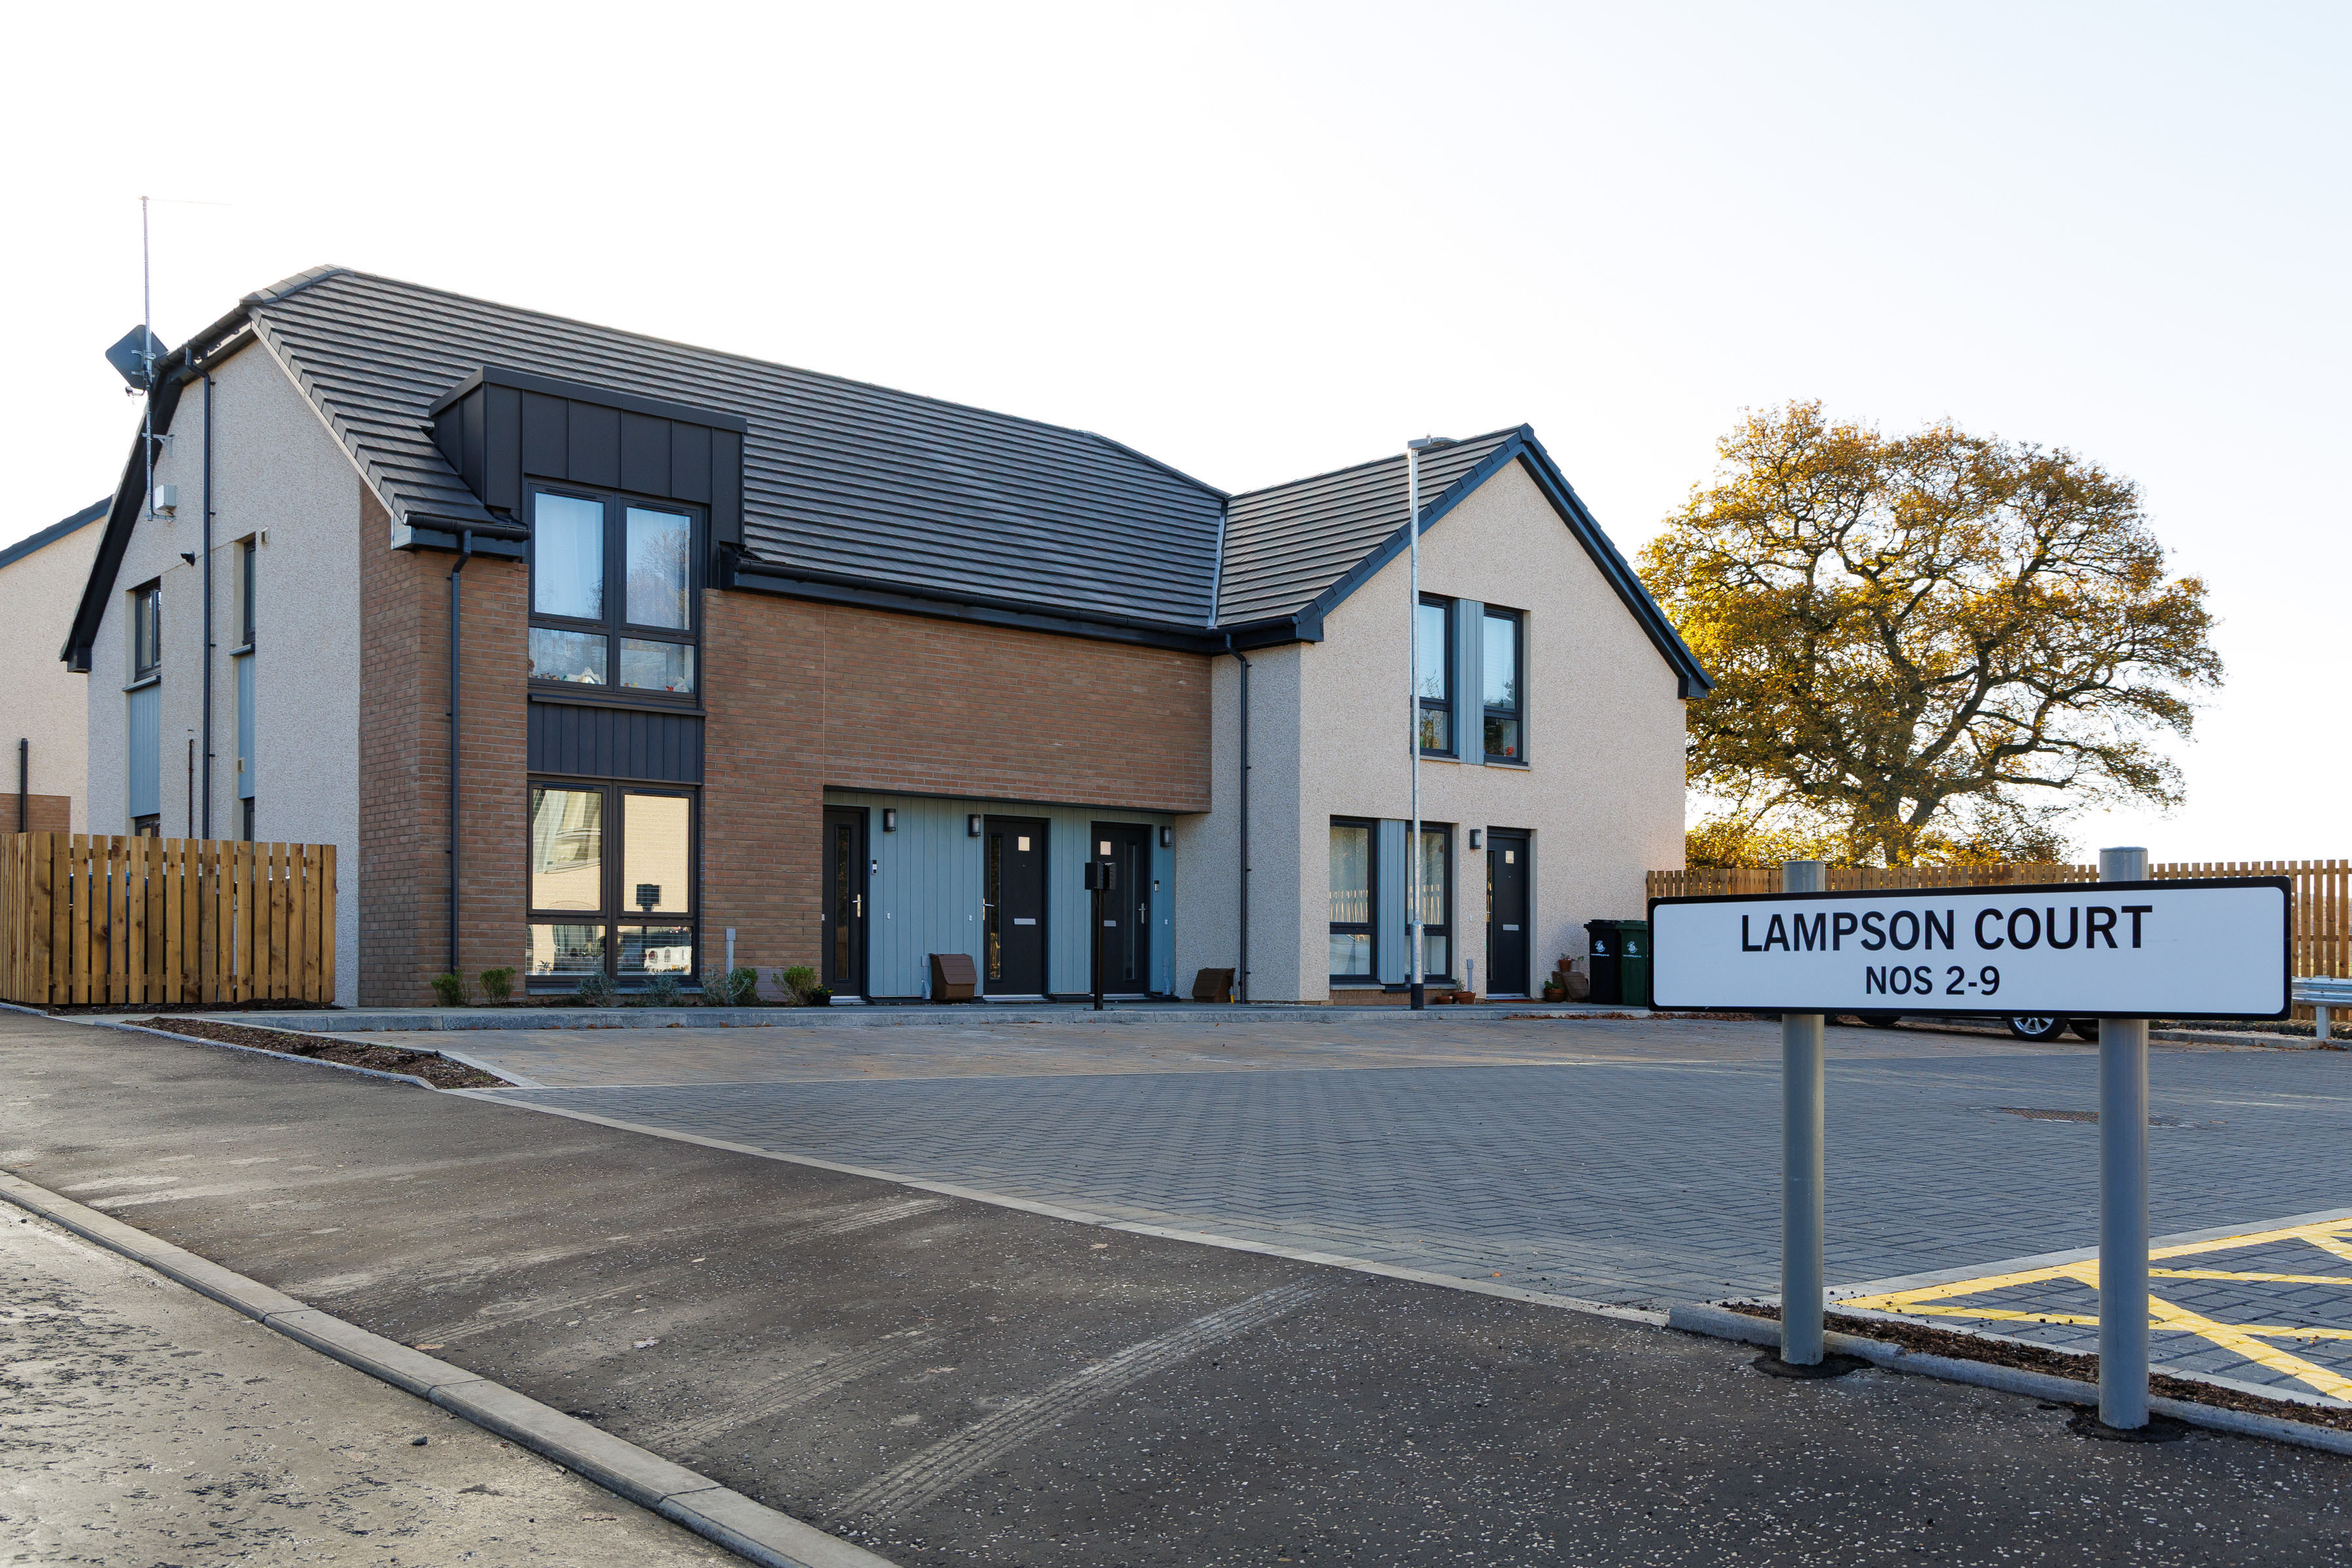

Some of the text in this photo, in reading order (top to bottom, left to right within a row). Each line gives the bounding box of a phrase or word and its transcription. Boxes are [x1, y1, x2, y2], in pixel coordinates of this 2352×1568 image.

[1741, 905, 2153, 953] LAMPSON COURT
[1865, 965, 2001, 996] NOS 2-9
